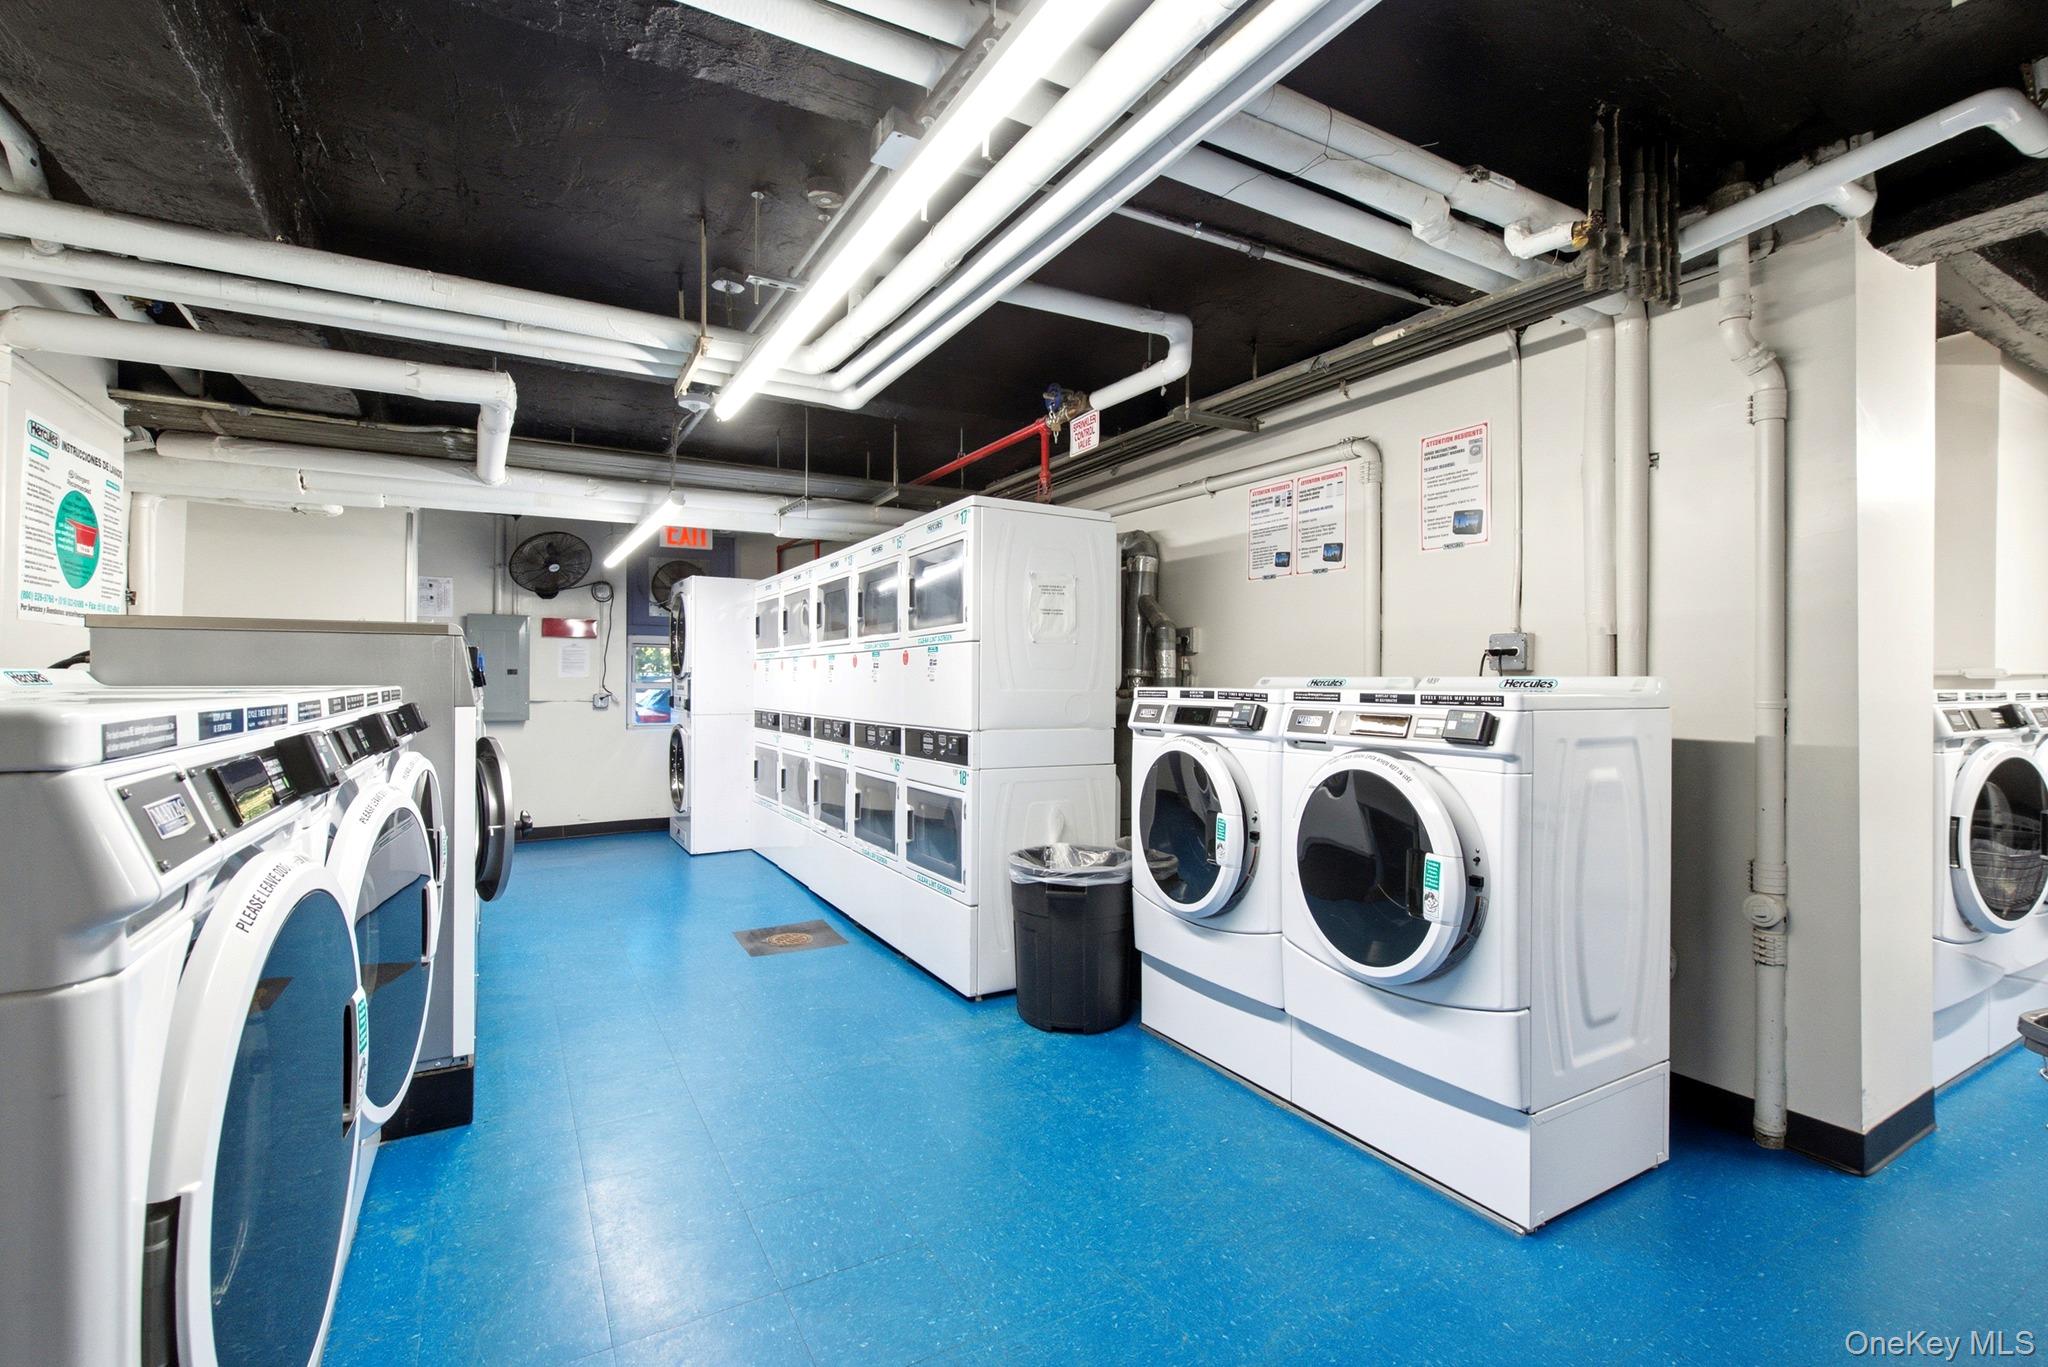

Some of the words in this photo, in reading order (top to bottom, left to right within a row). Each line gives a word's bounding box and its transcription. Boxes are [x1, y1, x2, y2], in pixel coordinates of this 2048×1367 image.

[30, 420, 58, 447] Hercules
[1074, 426, 1095, 442] CONTROL
[1426, 436, 1453, 448] ATTENTION
[1454, 428, 1483, 441] RESIDENTS
[1077, 437, 1091, 449] VALVE
[960, 509, 968, 525] 17
[1309, 678, 1345, 688] Hercules
[1502, 679, 1554, 689] Hercules
[959, 769, 968, 786] 18
[235, 893, 267, 934] PLEASE
[256, 872, 282, 898] LEAVE
